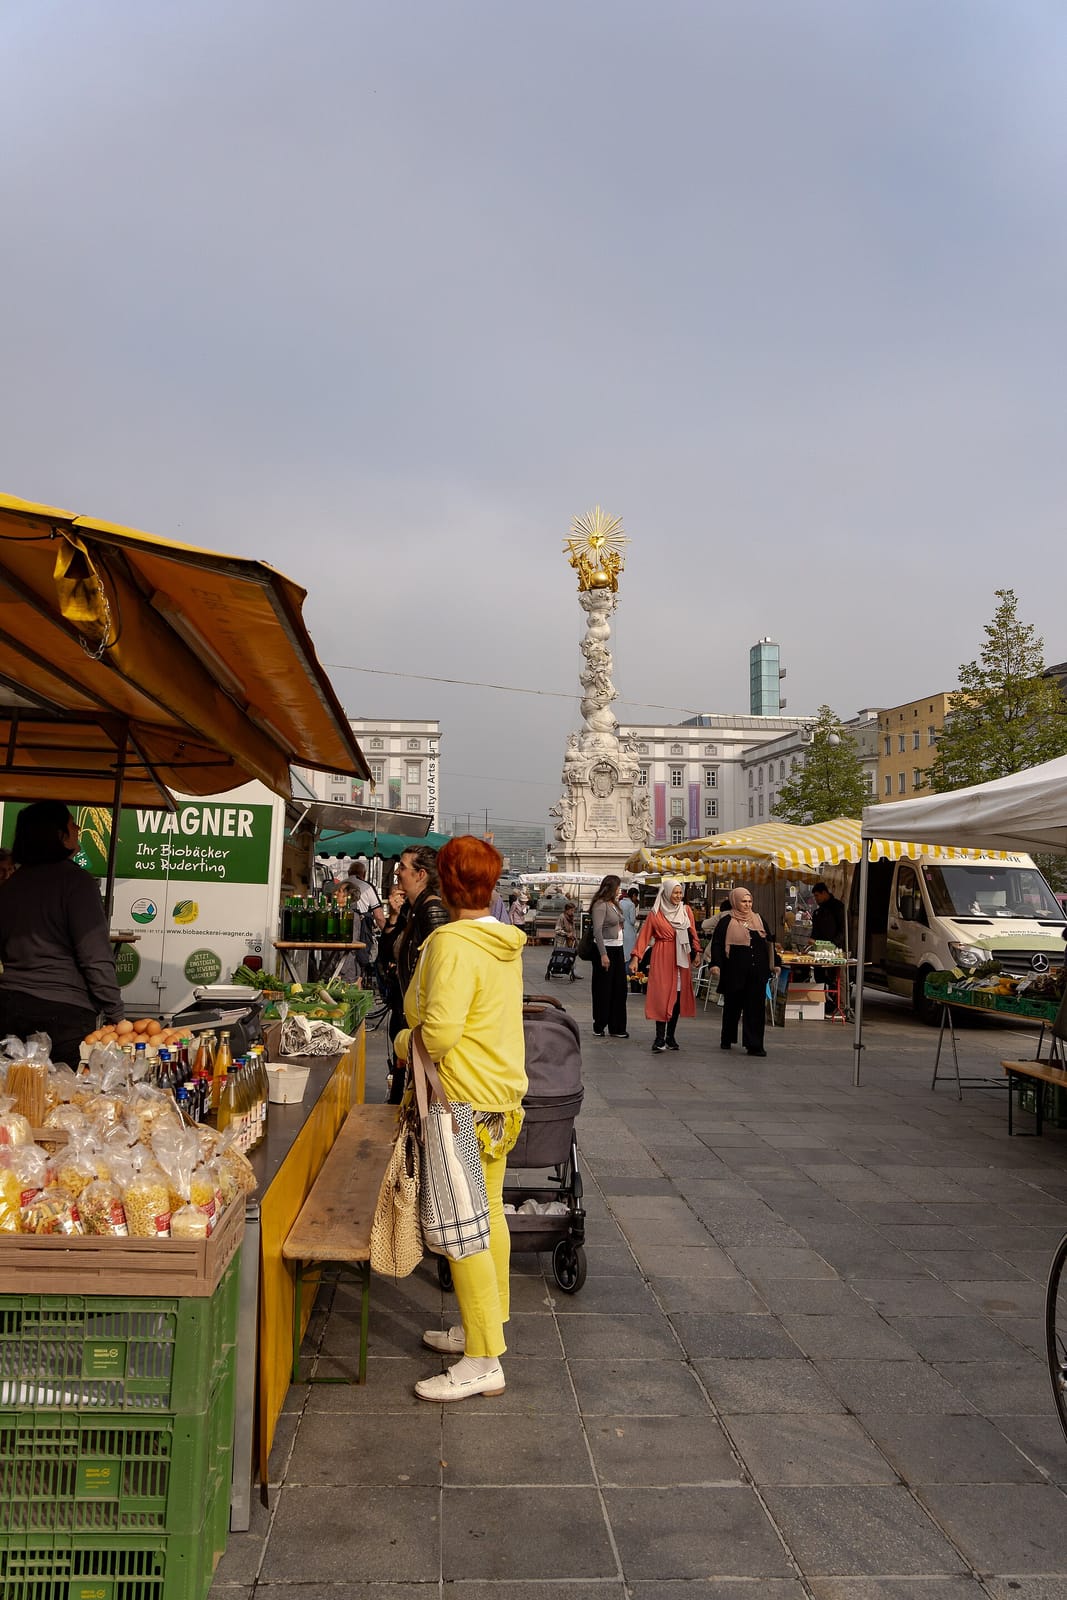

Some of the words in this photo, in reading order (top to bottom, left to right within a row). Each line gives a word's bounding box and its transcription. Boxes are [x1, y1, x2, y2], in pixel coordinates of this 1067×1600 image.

[427, 763, 435, 784] Arts
[428, 785, 435, 795] of
[136, 807, 254, 838] WAGNER
[136, 843, 158, 856] Ihr
[160, 844, 230, 859] Biobäcker
[135, 861, 156, 870] aus
[160, 858, 226, 879] Ruderting
[166, 928, 253, 937] www.biobaeckerei-wagner.de
